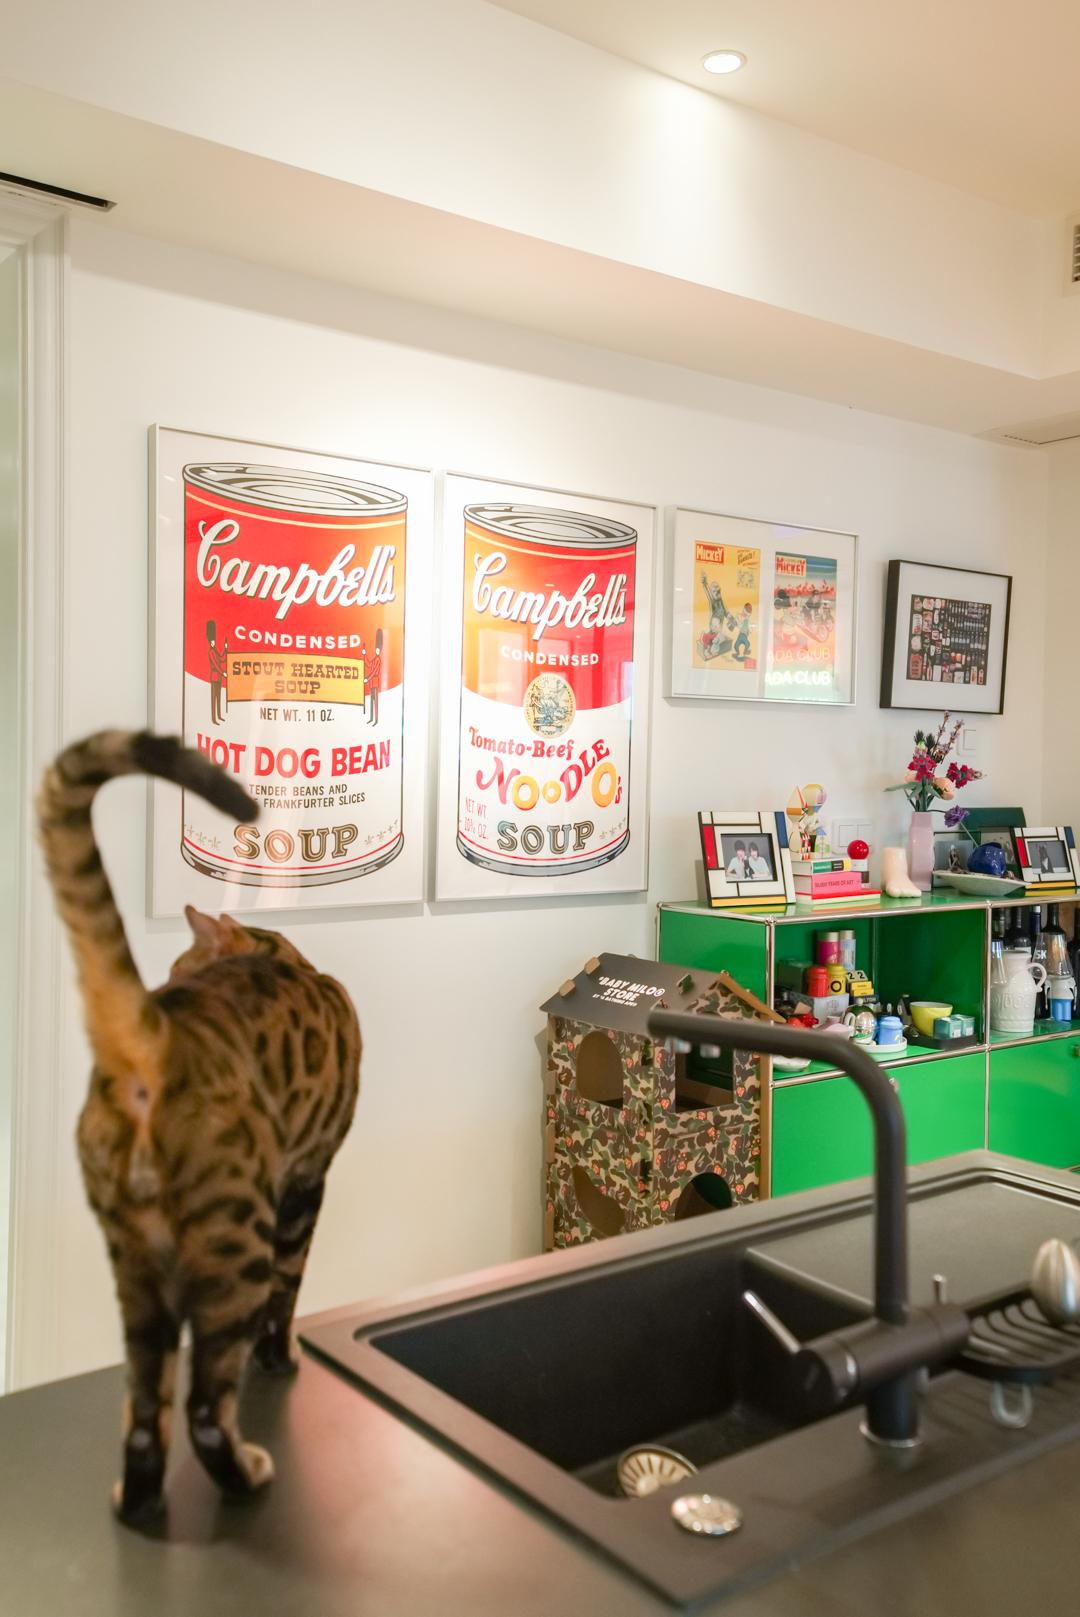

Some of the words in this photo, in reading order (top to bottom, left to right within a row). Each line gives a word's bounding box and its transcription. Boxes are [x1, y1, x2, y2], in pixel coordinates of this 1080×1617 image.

[196, 519, 396, 620] Campbell's
[472, 552, 627, 641] Campbell's
[235, 626, 361, 650] CONDENSED
[501, 645, 599, 666] CONDENSED
[232, 661, 284, 677] STOUT
[291, 664, 359, 680] HEARTED
[275, 681, 321, 695] SOUP
[260, 708, 278, 721] NET
[283, 709, 301, 722] WT.
[307, 710, 316, 722] 11
[320, 709, 335, 722] OZ.
[469, 726, 575, 760] Tomato-Beef
[255, 746, 321, 779] DOG
[331, 739, 391, 777] BEAN
[249, 784, 290, 797] TENDER
[293, 785, 324, 797] BEANS
[329, 784, 348, 795] AND
[264, 797, 334, 809] FRANKFURTER
[339, 792, 366, 806] SLICES
[466, 797, 475, 813] NET
[233, 824, 359, 863] SOUP
[497, 820, 595, 855] SOUP
[603, 988, 640, 1002] STORE
